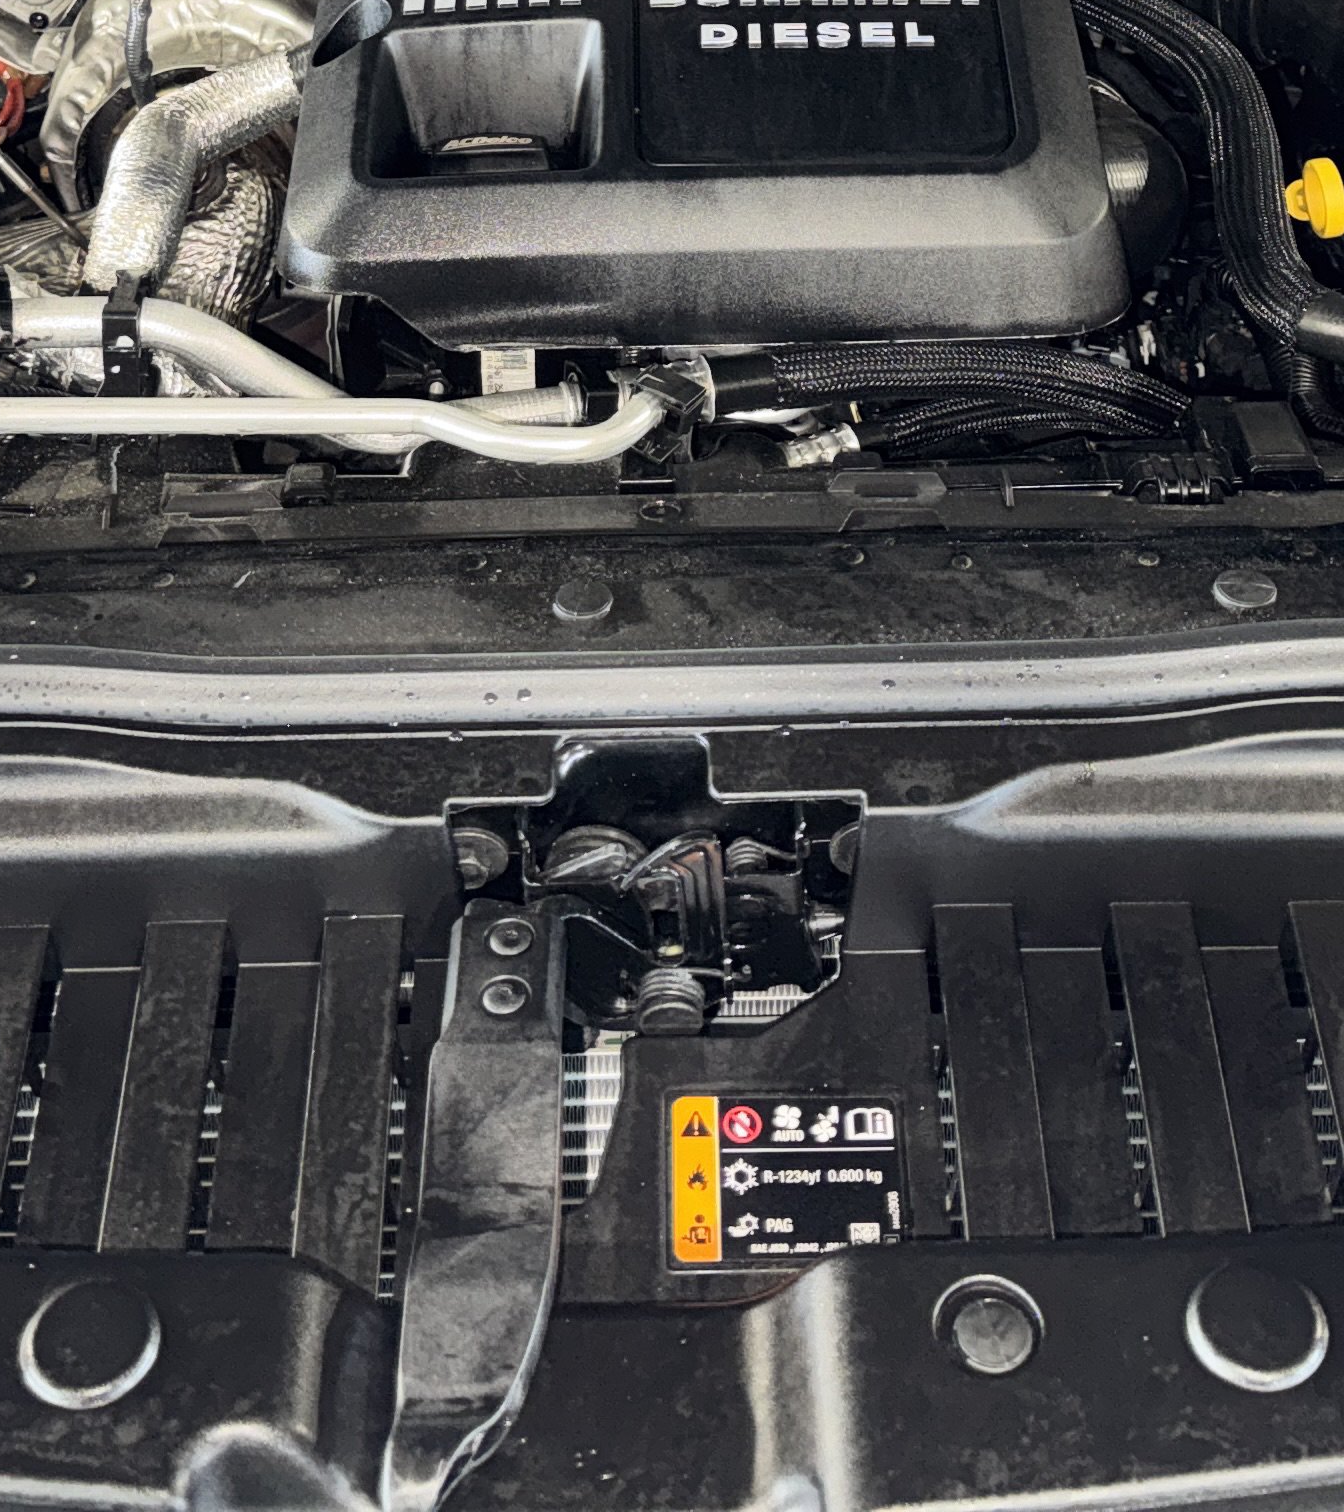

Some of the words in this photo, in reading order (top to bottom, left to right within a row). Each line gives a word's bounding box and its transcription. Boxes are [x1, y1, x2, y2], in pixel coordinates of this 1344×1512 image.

[700, 21, 935, 49] DIESEL
[441, 135, 533, 152] ACDelco
[773, 1129, 805, 1142] AUTO
[762, 1169, 821, 1186] R-1234yf
[827, 1169, 864, 1183] 0.600
[866, 1169, 883, 1185] kg
[766, 1218, 794, 1233] PAG
